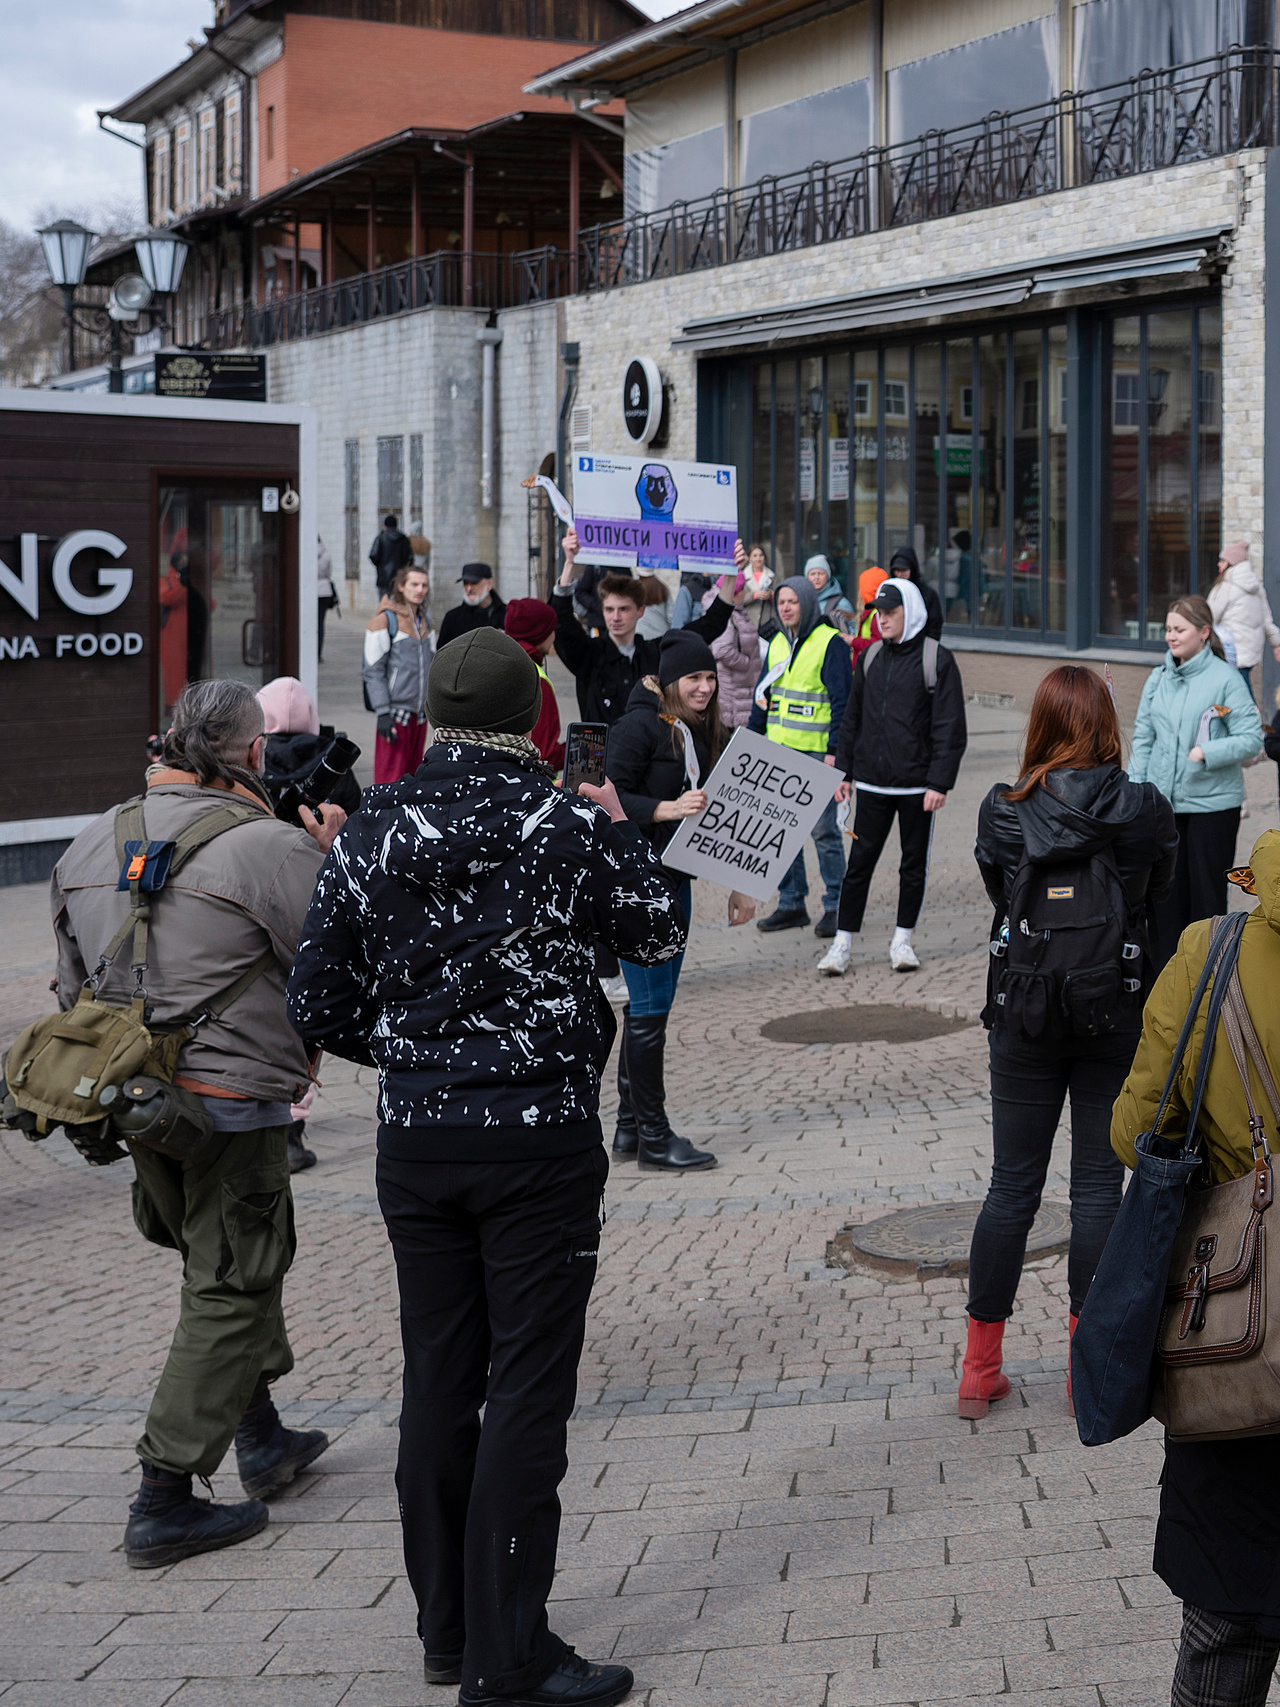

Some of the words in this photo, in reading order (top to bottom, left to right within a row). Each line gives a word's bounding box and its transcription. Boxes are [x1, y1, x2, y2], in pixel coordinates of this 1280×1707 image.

[584, 524, 650, 547] ОТПУСТИ
[664, 530, 728, 553] ГУСЕЙ!!!
[56, 632, 144, 658] FOOD
[731, 753, 814, 806] ЗДЕСЬ
[716, 783, 761, 812] МОГЛА
[762, 802, 799, 828] БЫТЬ
[698, 801, 786, 859] ВАША
[686, 832, 770, 878] РЕКЛАМА
